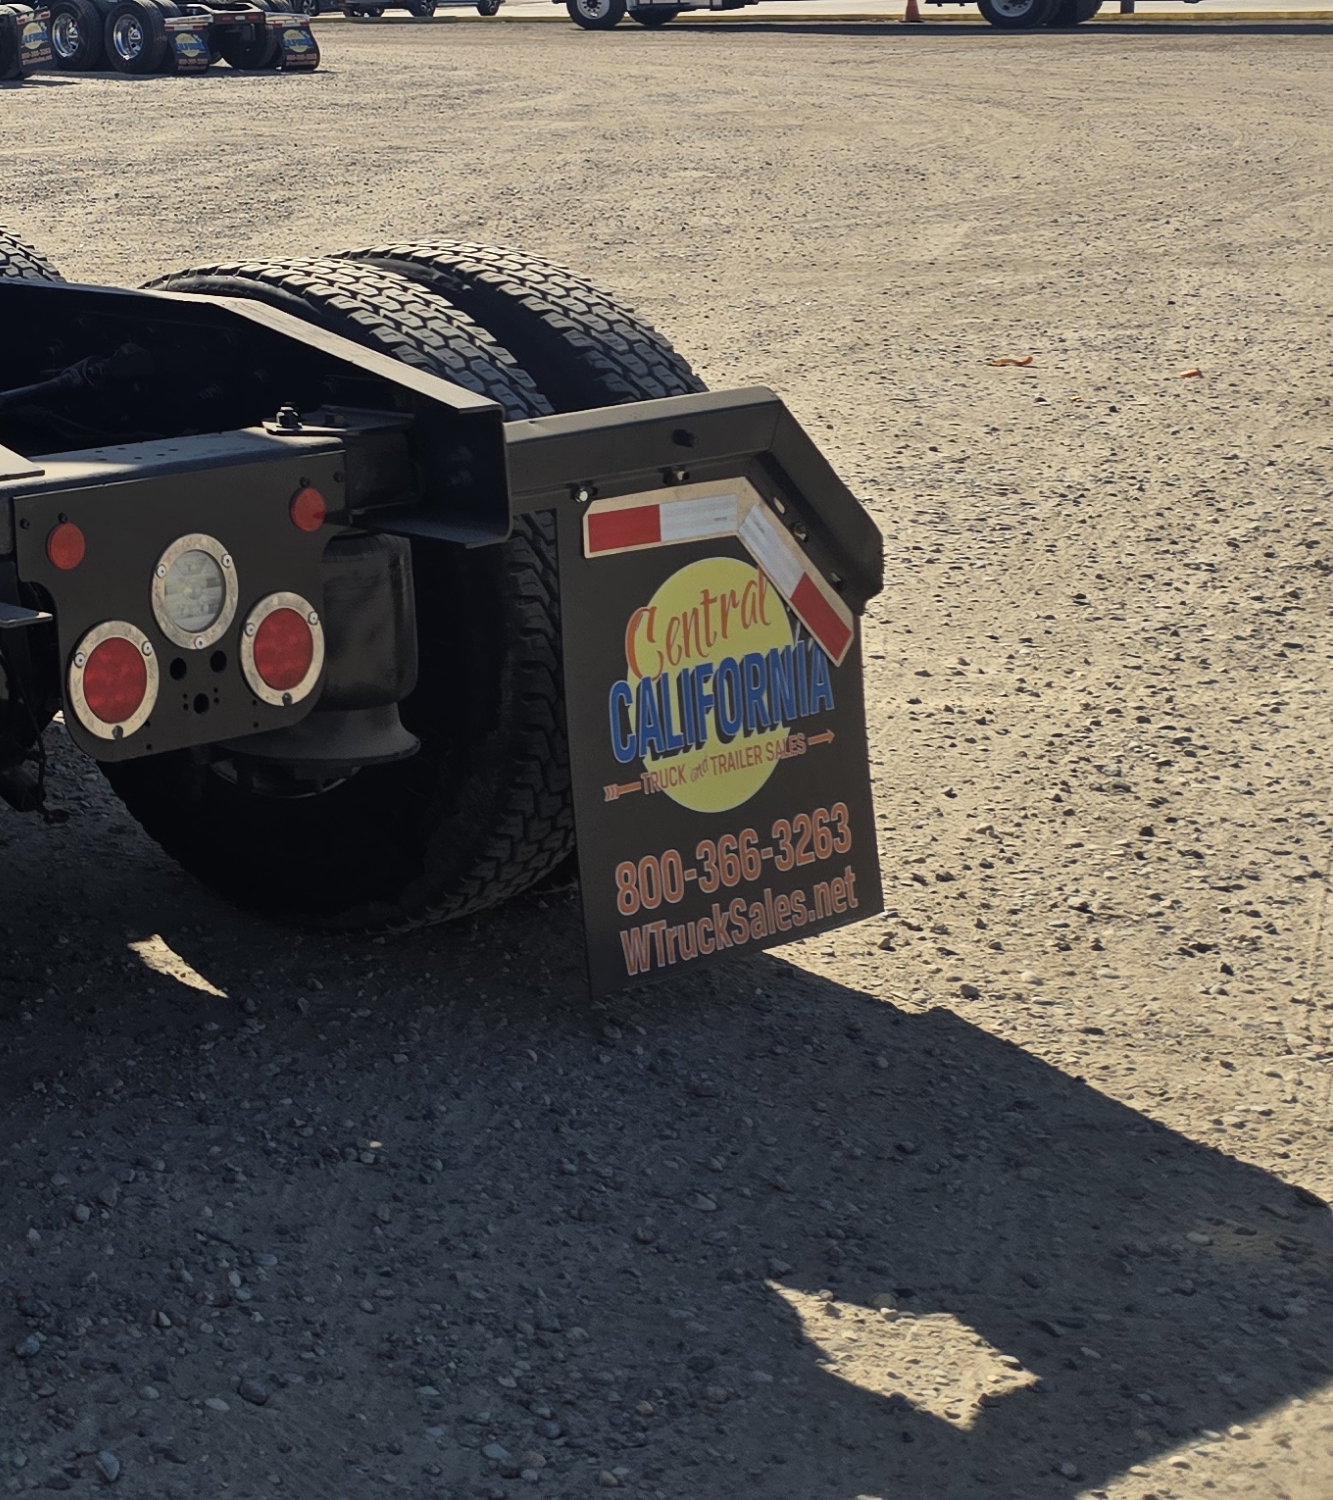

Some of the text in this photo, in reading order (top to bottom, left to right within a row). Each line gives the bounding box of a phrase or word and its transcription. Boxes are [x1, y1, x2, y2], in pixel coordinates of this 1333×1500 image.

[625, 567, 773, 685] Central
[608, 637, 834, 764] CALIFORNIA
[640, 732, 808, 796] TRUCK and TRAILER SALES
[615, 802, 853, 917] 800-366-3263
[619, 866, 859, 976] WTruckSales.net
